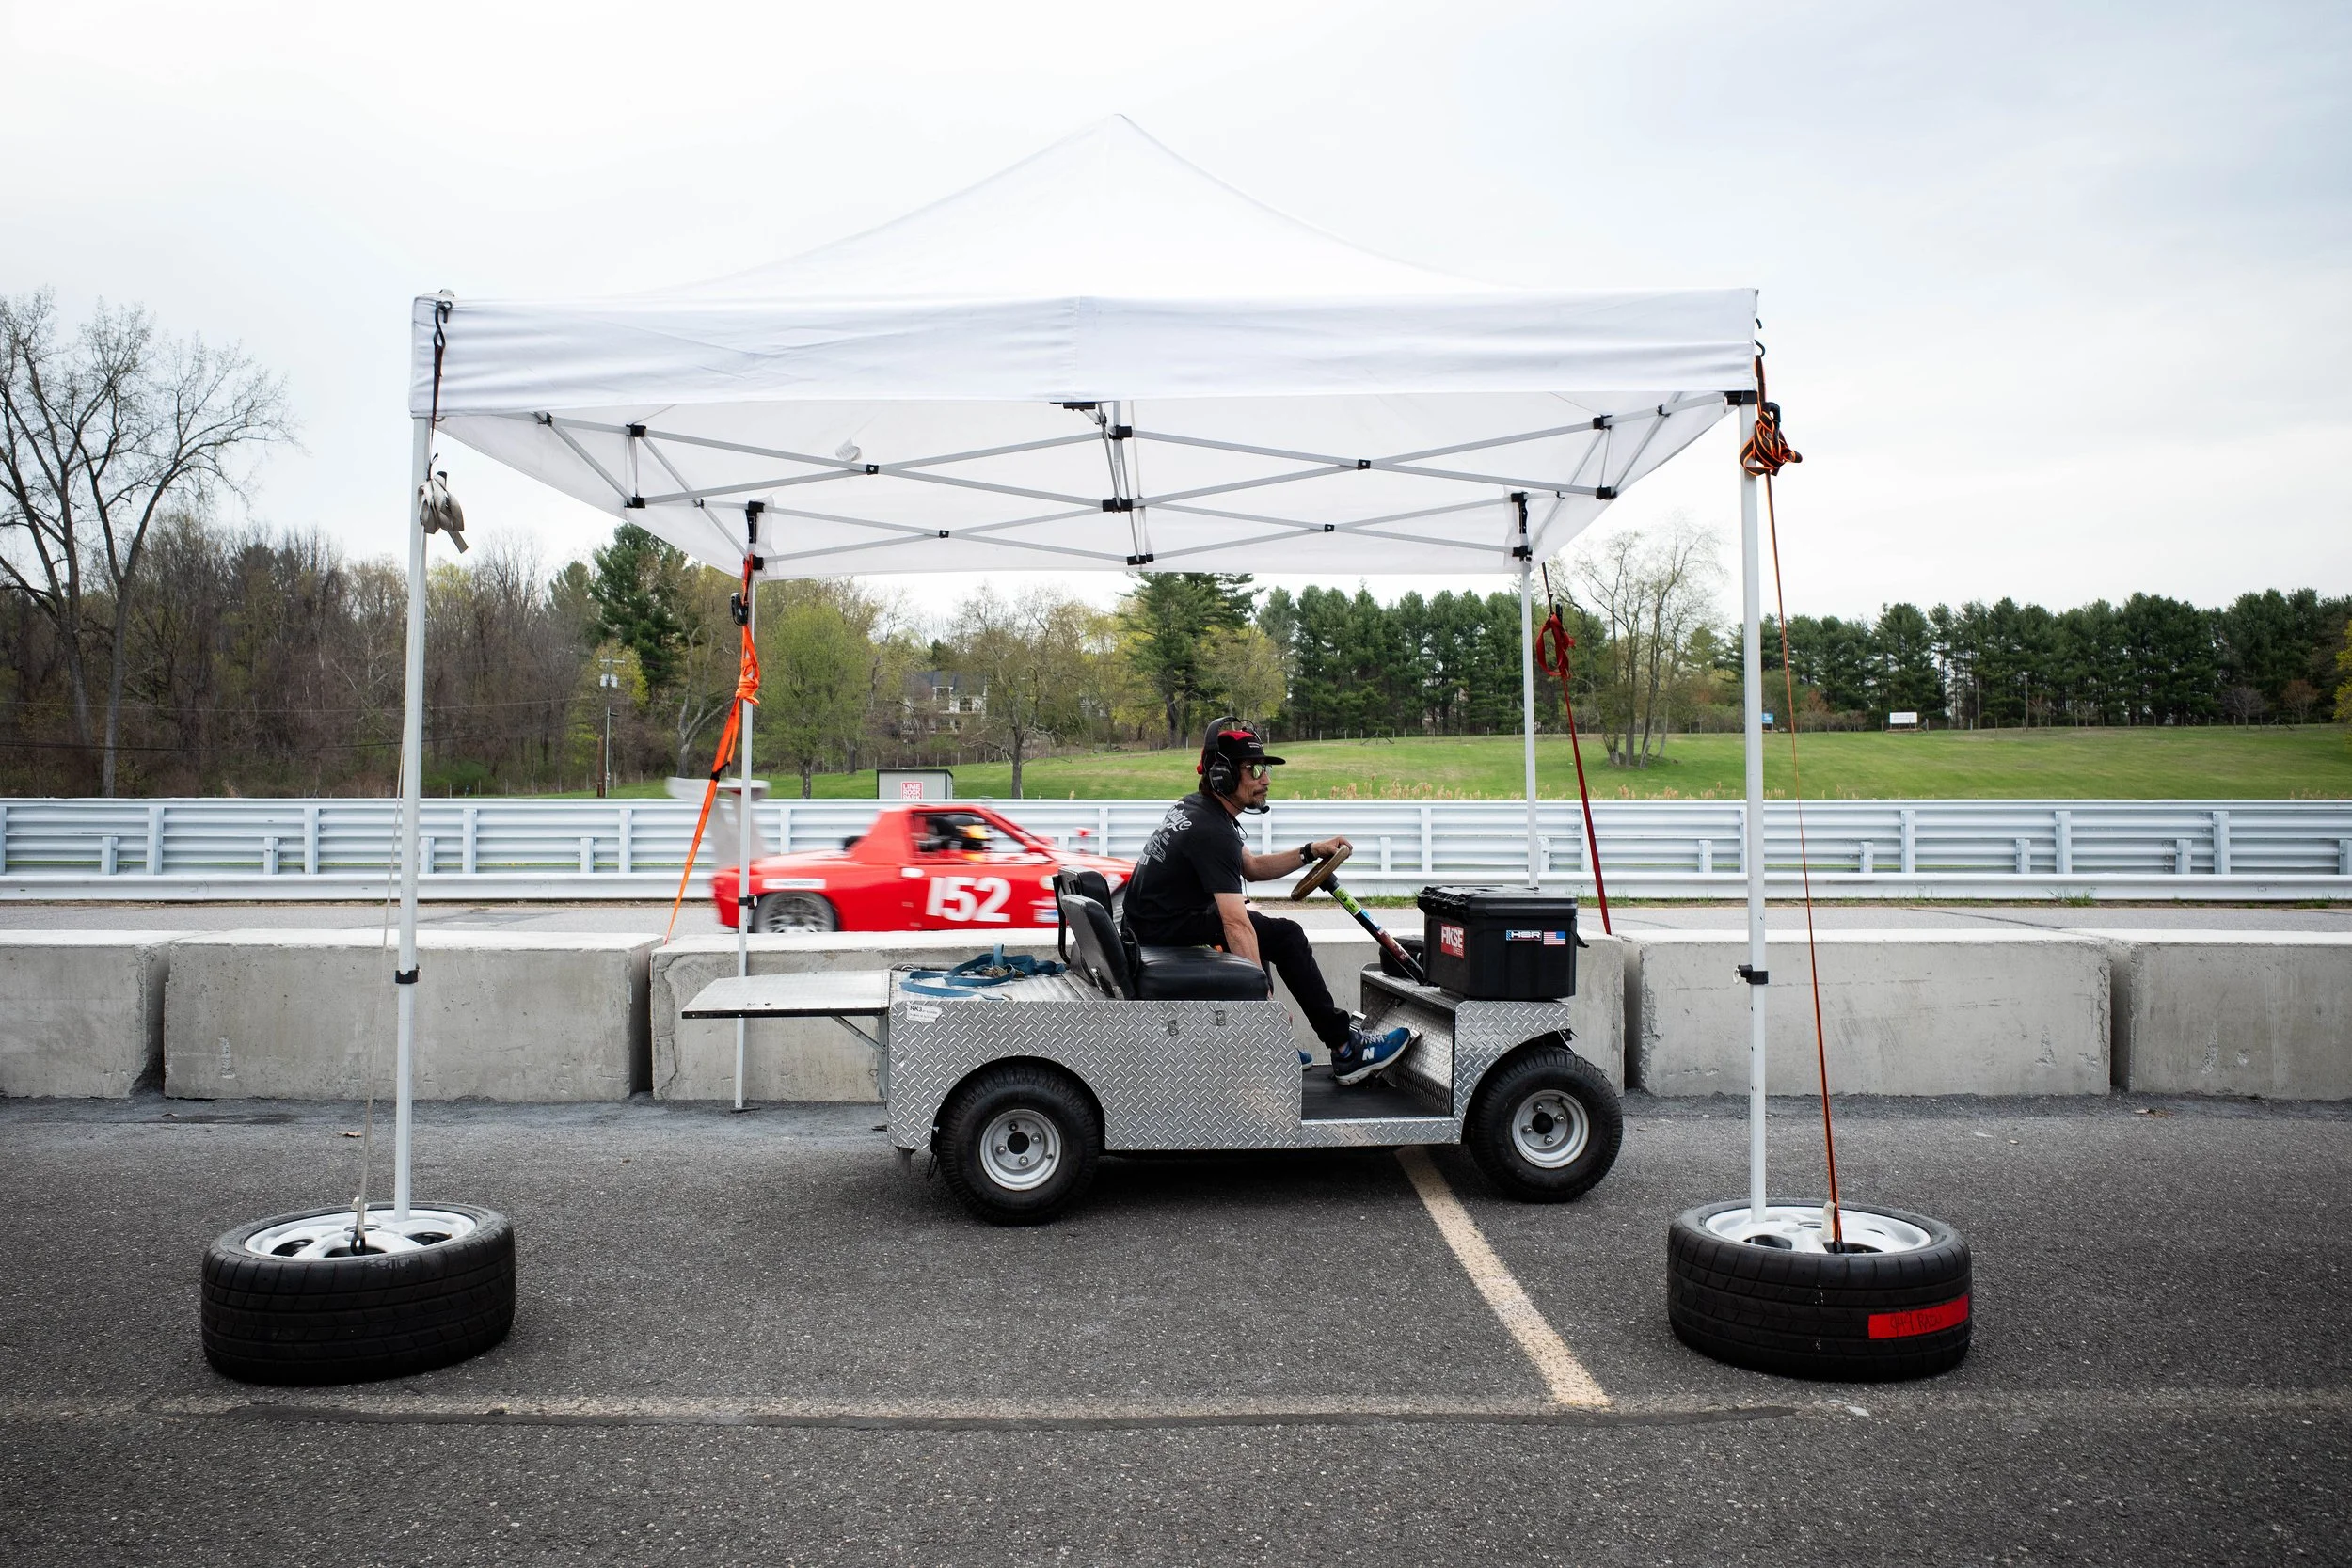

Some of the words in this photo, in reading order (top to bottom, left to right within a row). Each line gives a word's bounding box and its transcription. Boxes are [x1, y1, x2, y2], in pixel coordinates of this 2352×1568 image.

[926, 877, 1011, 923] 152
[1441, 926, 1464, 948] FIKSE
[1511, 930, 1541, 939] HSR
[1362, 1047, 1375, 1061] N
